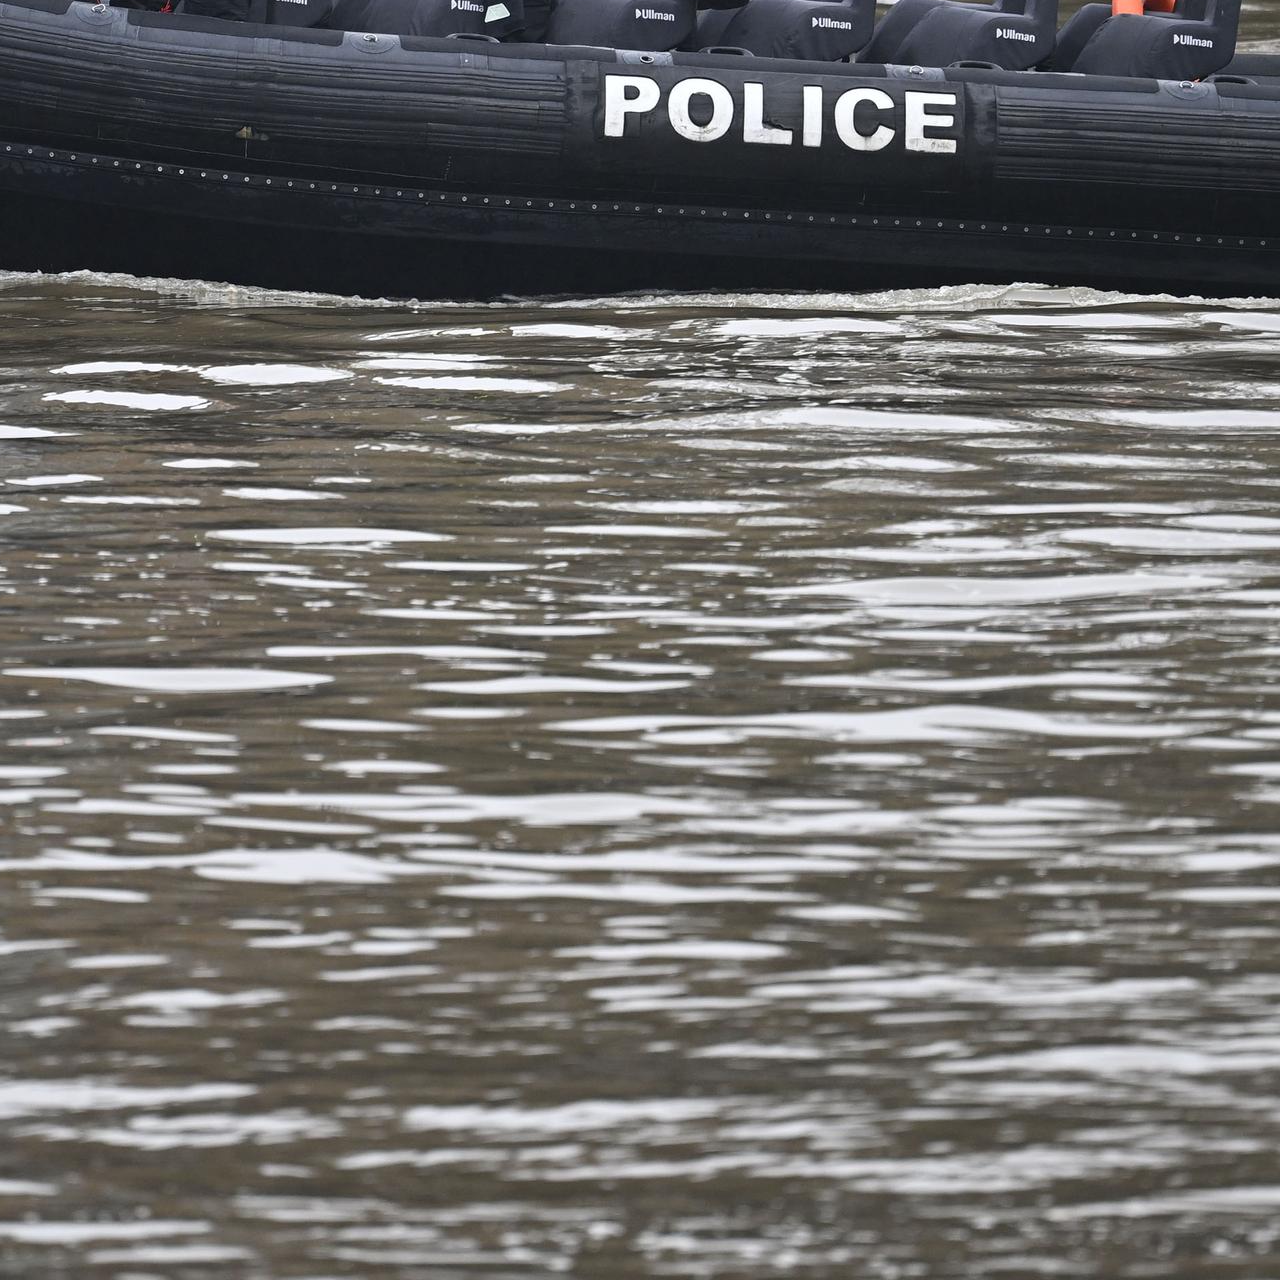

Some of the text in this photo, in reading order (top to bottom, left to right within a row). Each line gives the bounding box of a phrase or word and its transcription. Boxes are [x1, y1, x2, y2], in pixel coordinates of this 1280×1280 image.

[457, 0, 485, 13] Ullma
[641, 8, 675, 22] Ullman
[818, 17, 852, 30] Ullman
[1002, 28, 1036, 43] Ullman
[1179, 34, 1213, 49] Ullman
[604, 74, 957, 154] POLICE
